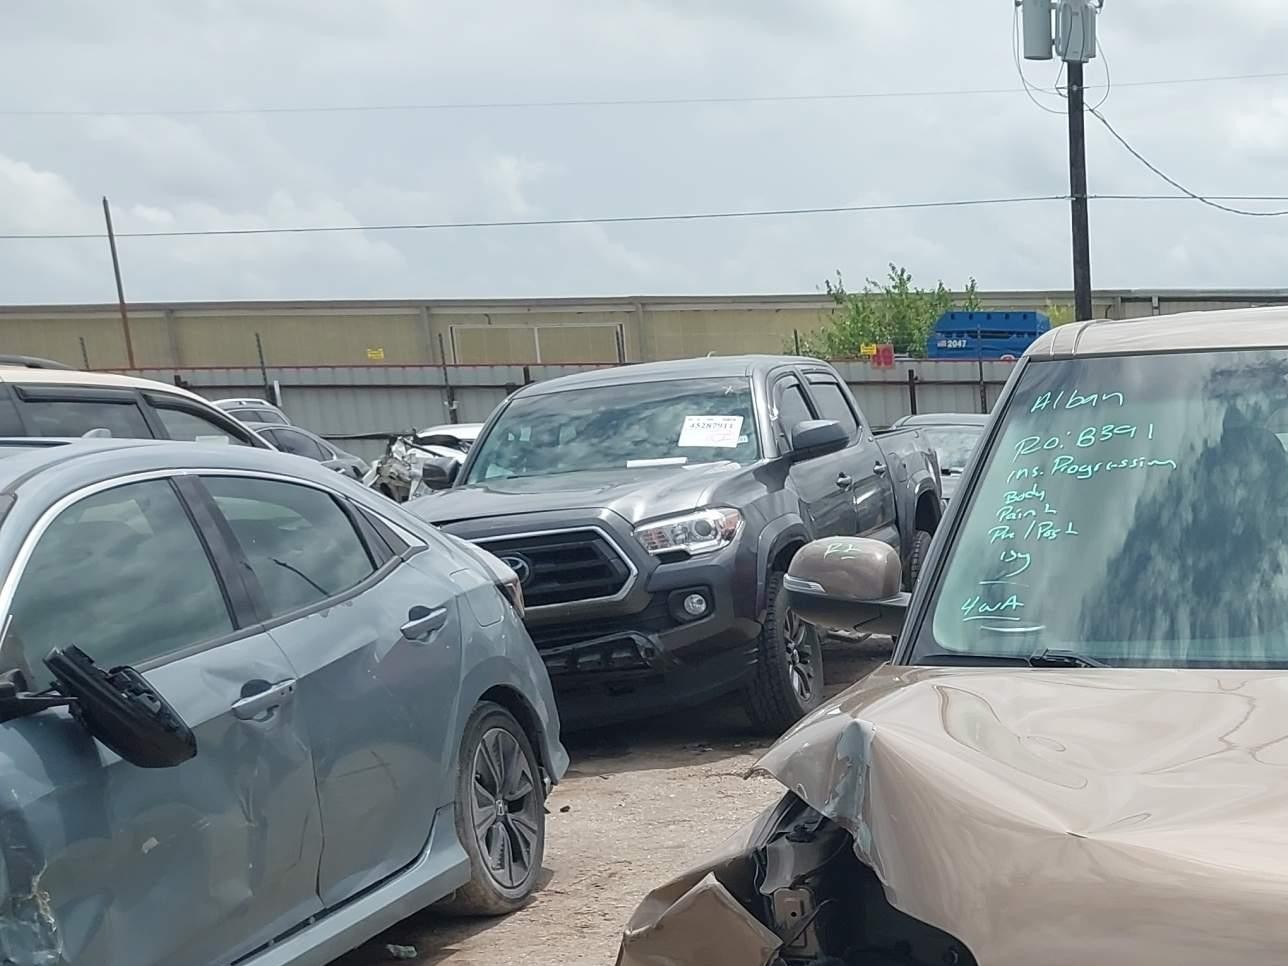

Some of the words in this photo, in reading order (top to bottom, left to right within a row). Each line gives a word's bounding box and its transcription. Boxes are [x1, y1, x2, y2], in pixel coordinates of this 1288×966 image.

[947, 339, 967, 348] 2047
[1031, 390, 1124, 413] Alban
[1003, 483, 1045, 504] Body
